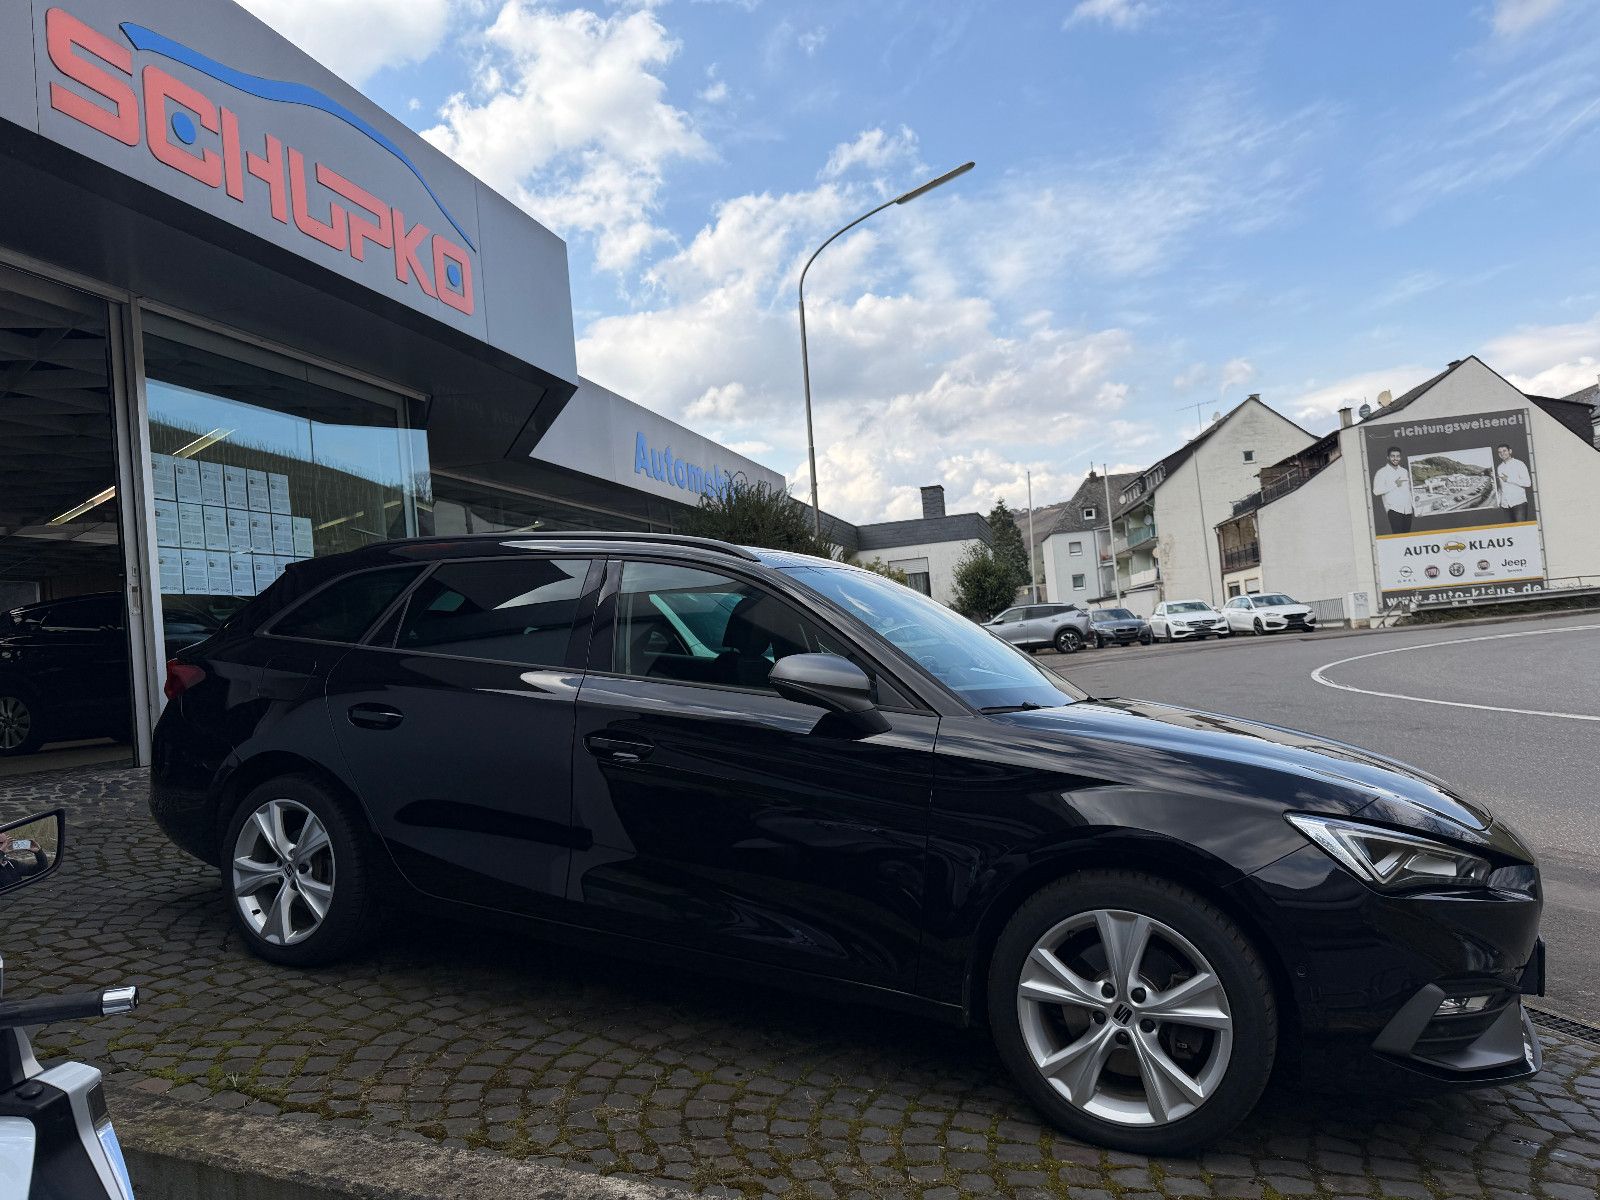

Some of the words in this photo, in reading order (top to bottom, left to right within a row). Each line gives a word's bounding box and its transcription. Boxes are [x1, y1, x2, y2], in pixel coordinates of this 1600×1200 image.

[45, 8, 475, 316] SCHUPKO
[1393, 414, 1524, 438] richtungsweisend!
[1404, 544, 1441, 557] AUTO
[1468, 537, 1515, 551] KLAUS
[1501, 558, 1527, 568] Jeep
